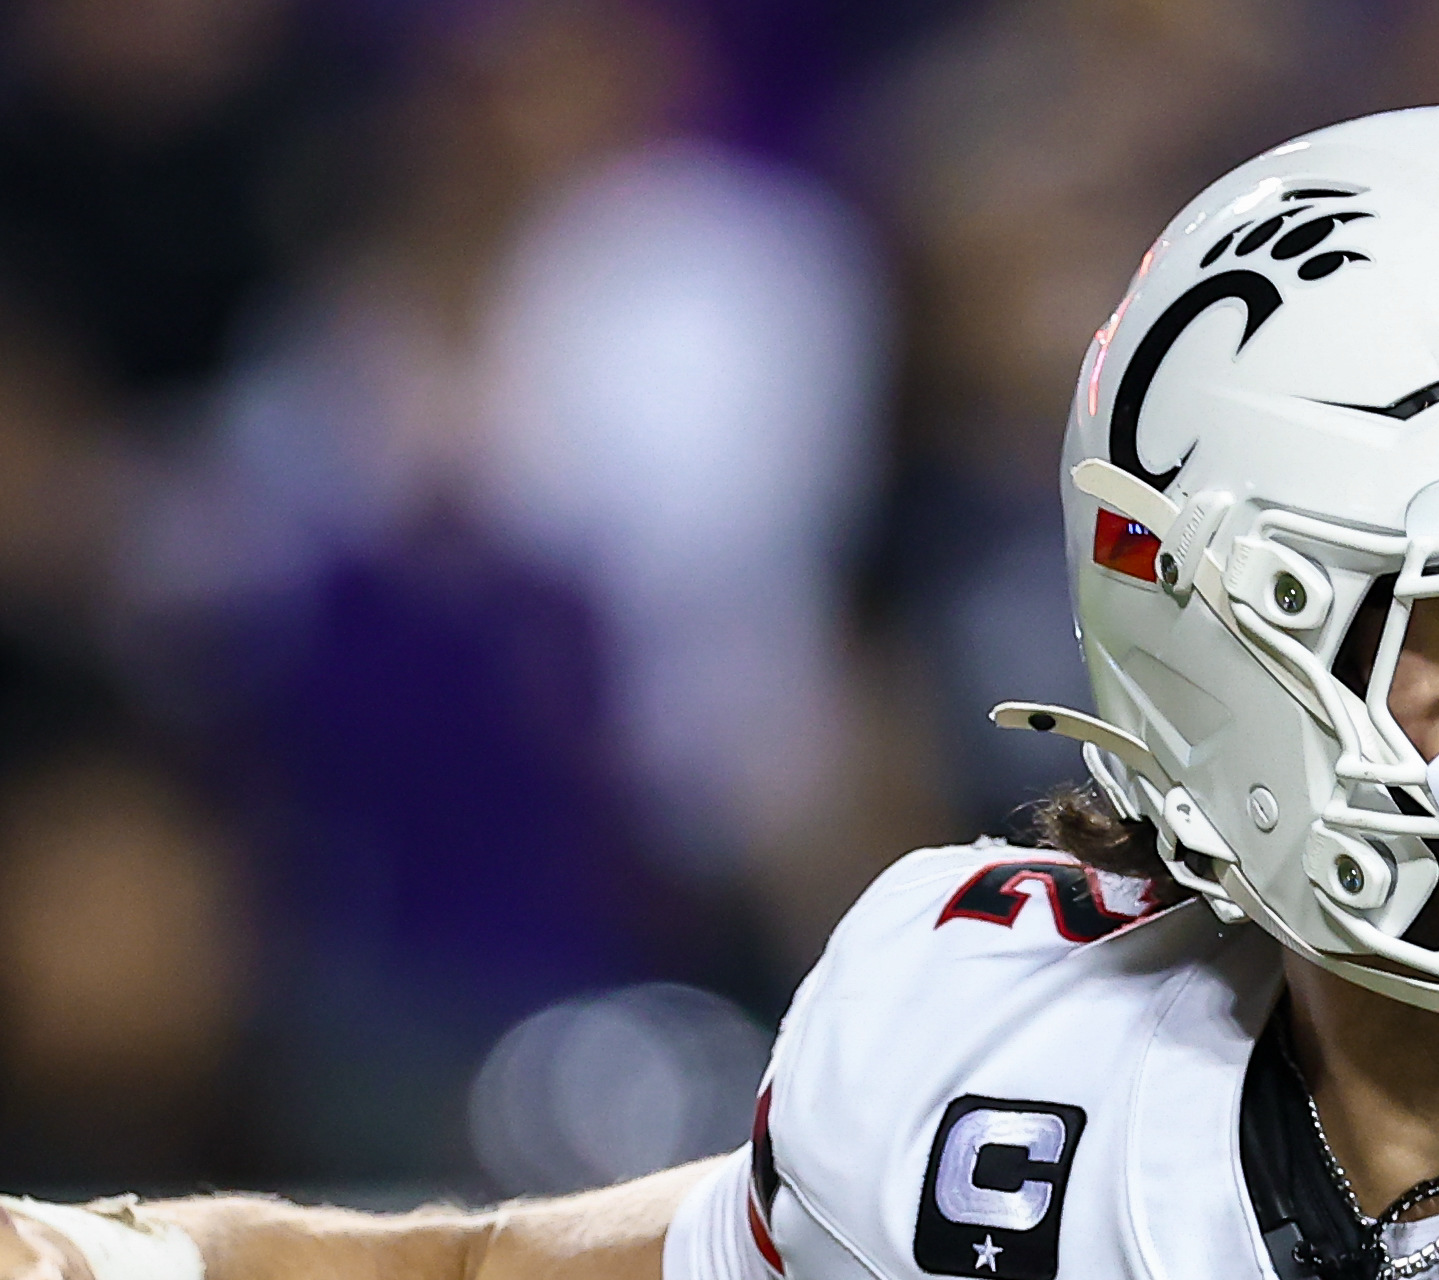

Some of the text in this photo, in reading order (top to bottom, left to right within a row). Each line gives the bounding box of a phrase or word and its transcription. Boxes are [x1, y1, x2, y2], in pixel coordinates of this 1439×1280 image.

[1108, 268, 1284, 491] C
[933, 858, 1160, 943] 2
[934, 1108, 1068, 1232] C
